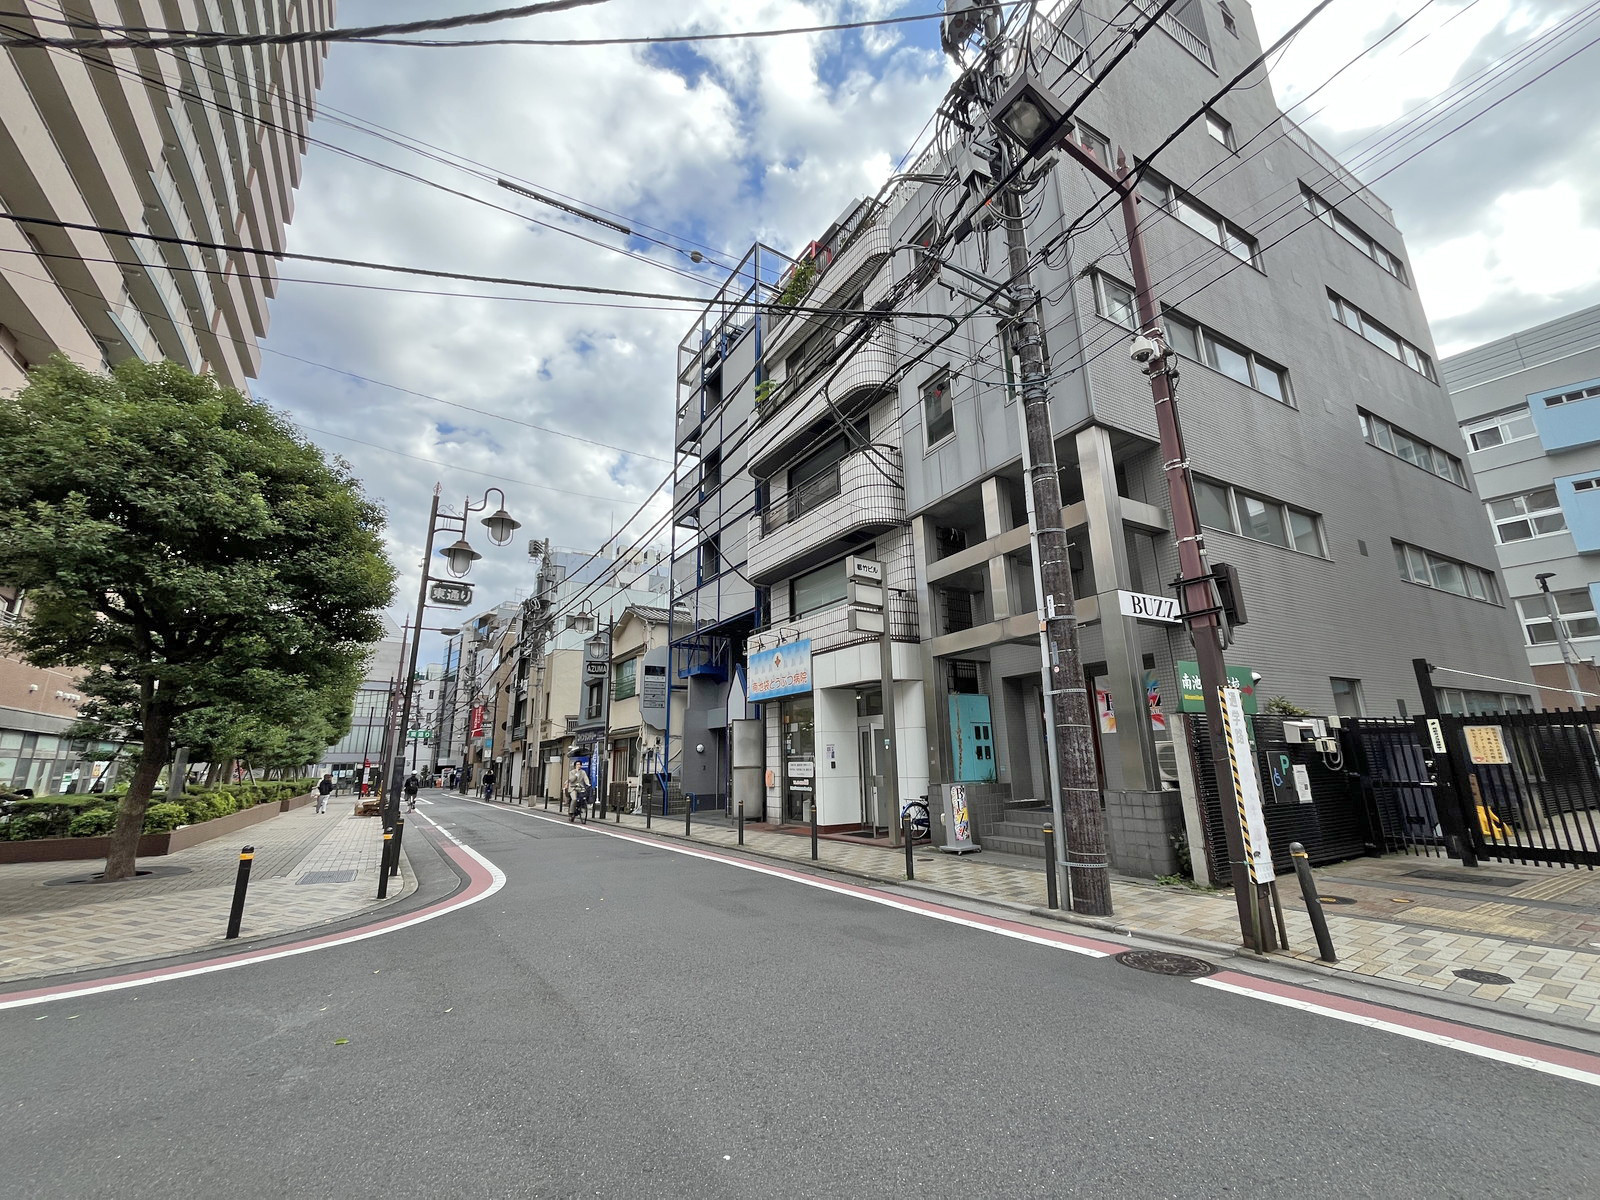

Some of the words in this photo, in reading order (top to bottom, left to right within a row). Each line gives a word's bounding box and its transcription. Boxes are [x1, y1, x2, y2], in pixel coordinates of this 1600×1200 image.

[432, 587, 471, 602] 東通り
[1130, 595, 1175, 619] BUZZ
[587, 664, 607, 673] AZUMA
[1280, 755, 1289, 776] P
